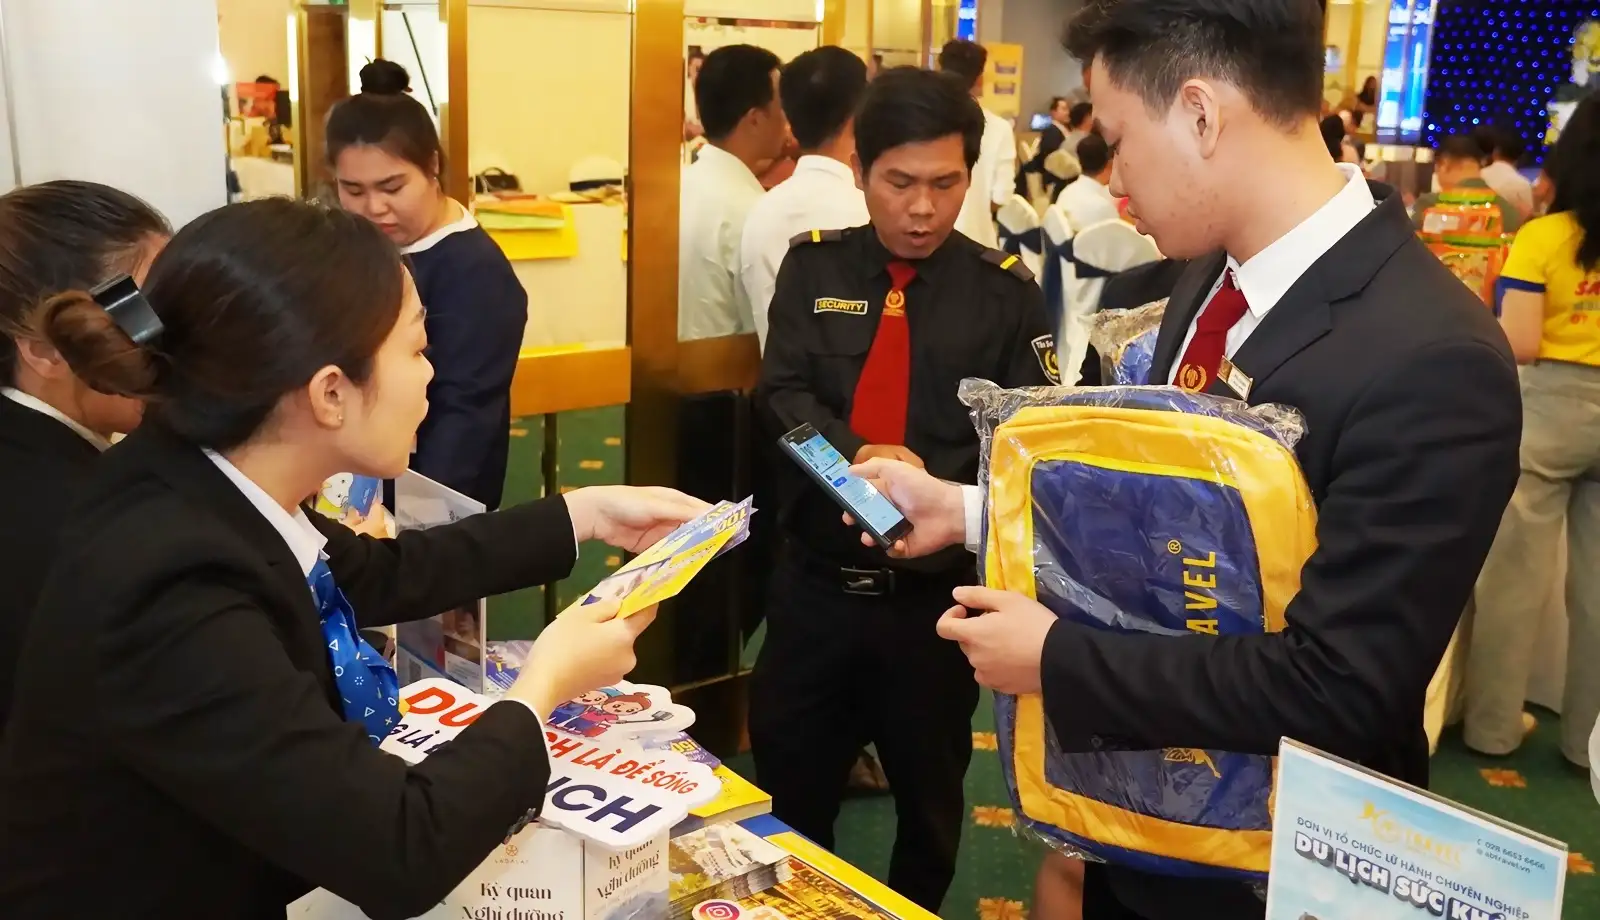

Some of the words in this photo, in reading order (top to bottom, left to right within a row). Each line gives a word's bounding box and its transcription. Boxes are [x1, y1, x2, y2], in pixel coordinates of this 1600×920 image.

[818, 300, 863, 311] SECURITY
[1182, 551, 1219, 636] AVEL
[405, 686, 487, 728] DU
[609, 759, 666, 780] ĐỂ
[643, 771, 699, 794] SỐNG
[506, 887, 551, 901] quan
[1295, 831, 1332, 864] DU
[1335, 848, 1390, 892] LỊCH
[1393, 876, 1445, 915] SỨC
[1322, 826, 1333, 840] VỊ
[1335, 830, 1349, 844] TỔ
[1351, 839, 1383, 859] CHỨC
[1400, 860, 1432, 881] HÀNH
[1435, 875, 1482, 901] CHUYÊN
[1485, 894, 1530, 920] NGHIỆP
